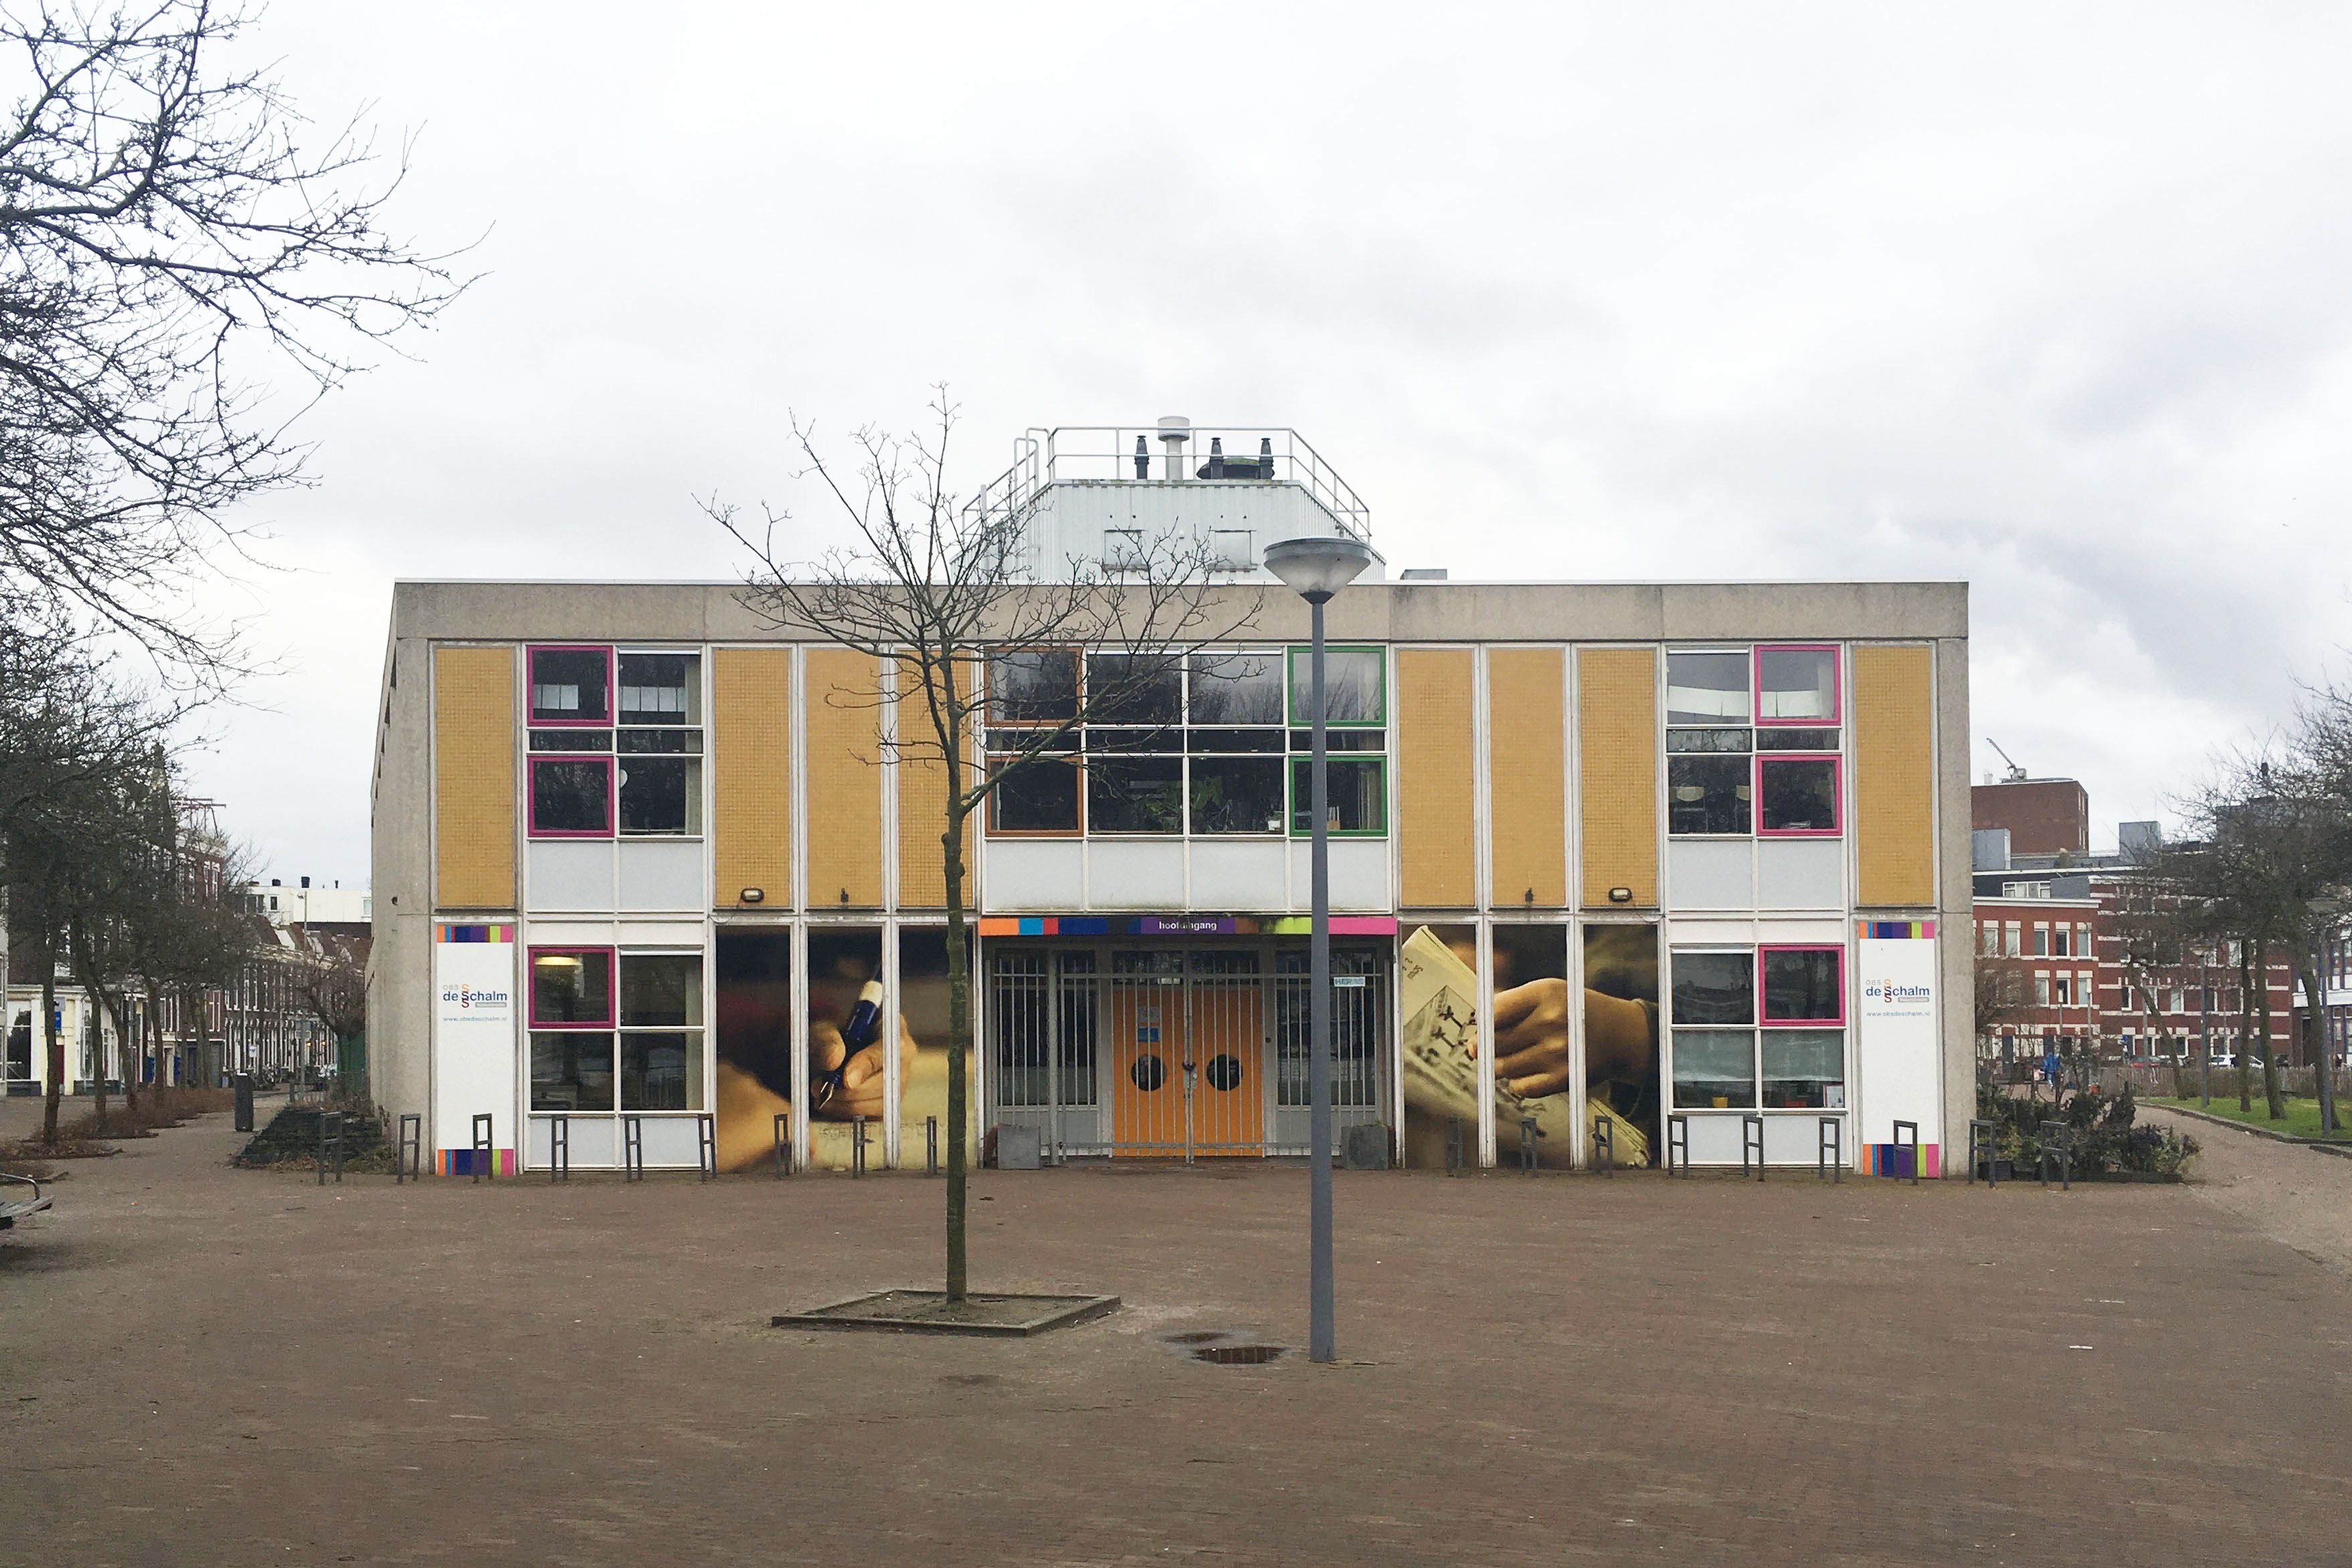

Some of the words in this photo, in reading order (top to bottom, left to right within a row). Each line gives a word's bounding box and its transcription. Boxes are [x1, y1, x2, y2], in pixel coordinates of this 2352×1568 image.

[1866, 986, 1881, 996] de
[1884, 985, 1930, 996] Schalm
[443, 991, 458, 1001] de
[461, 991, 507, 1001] Schalm
